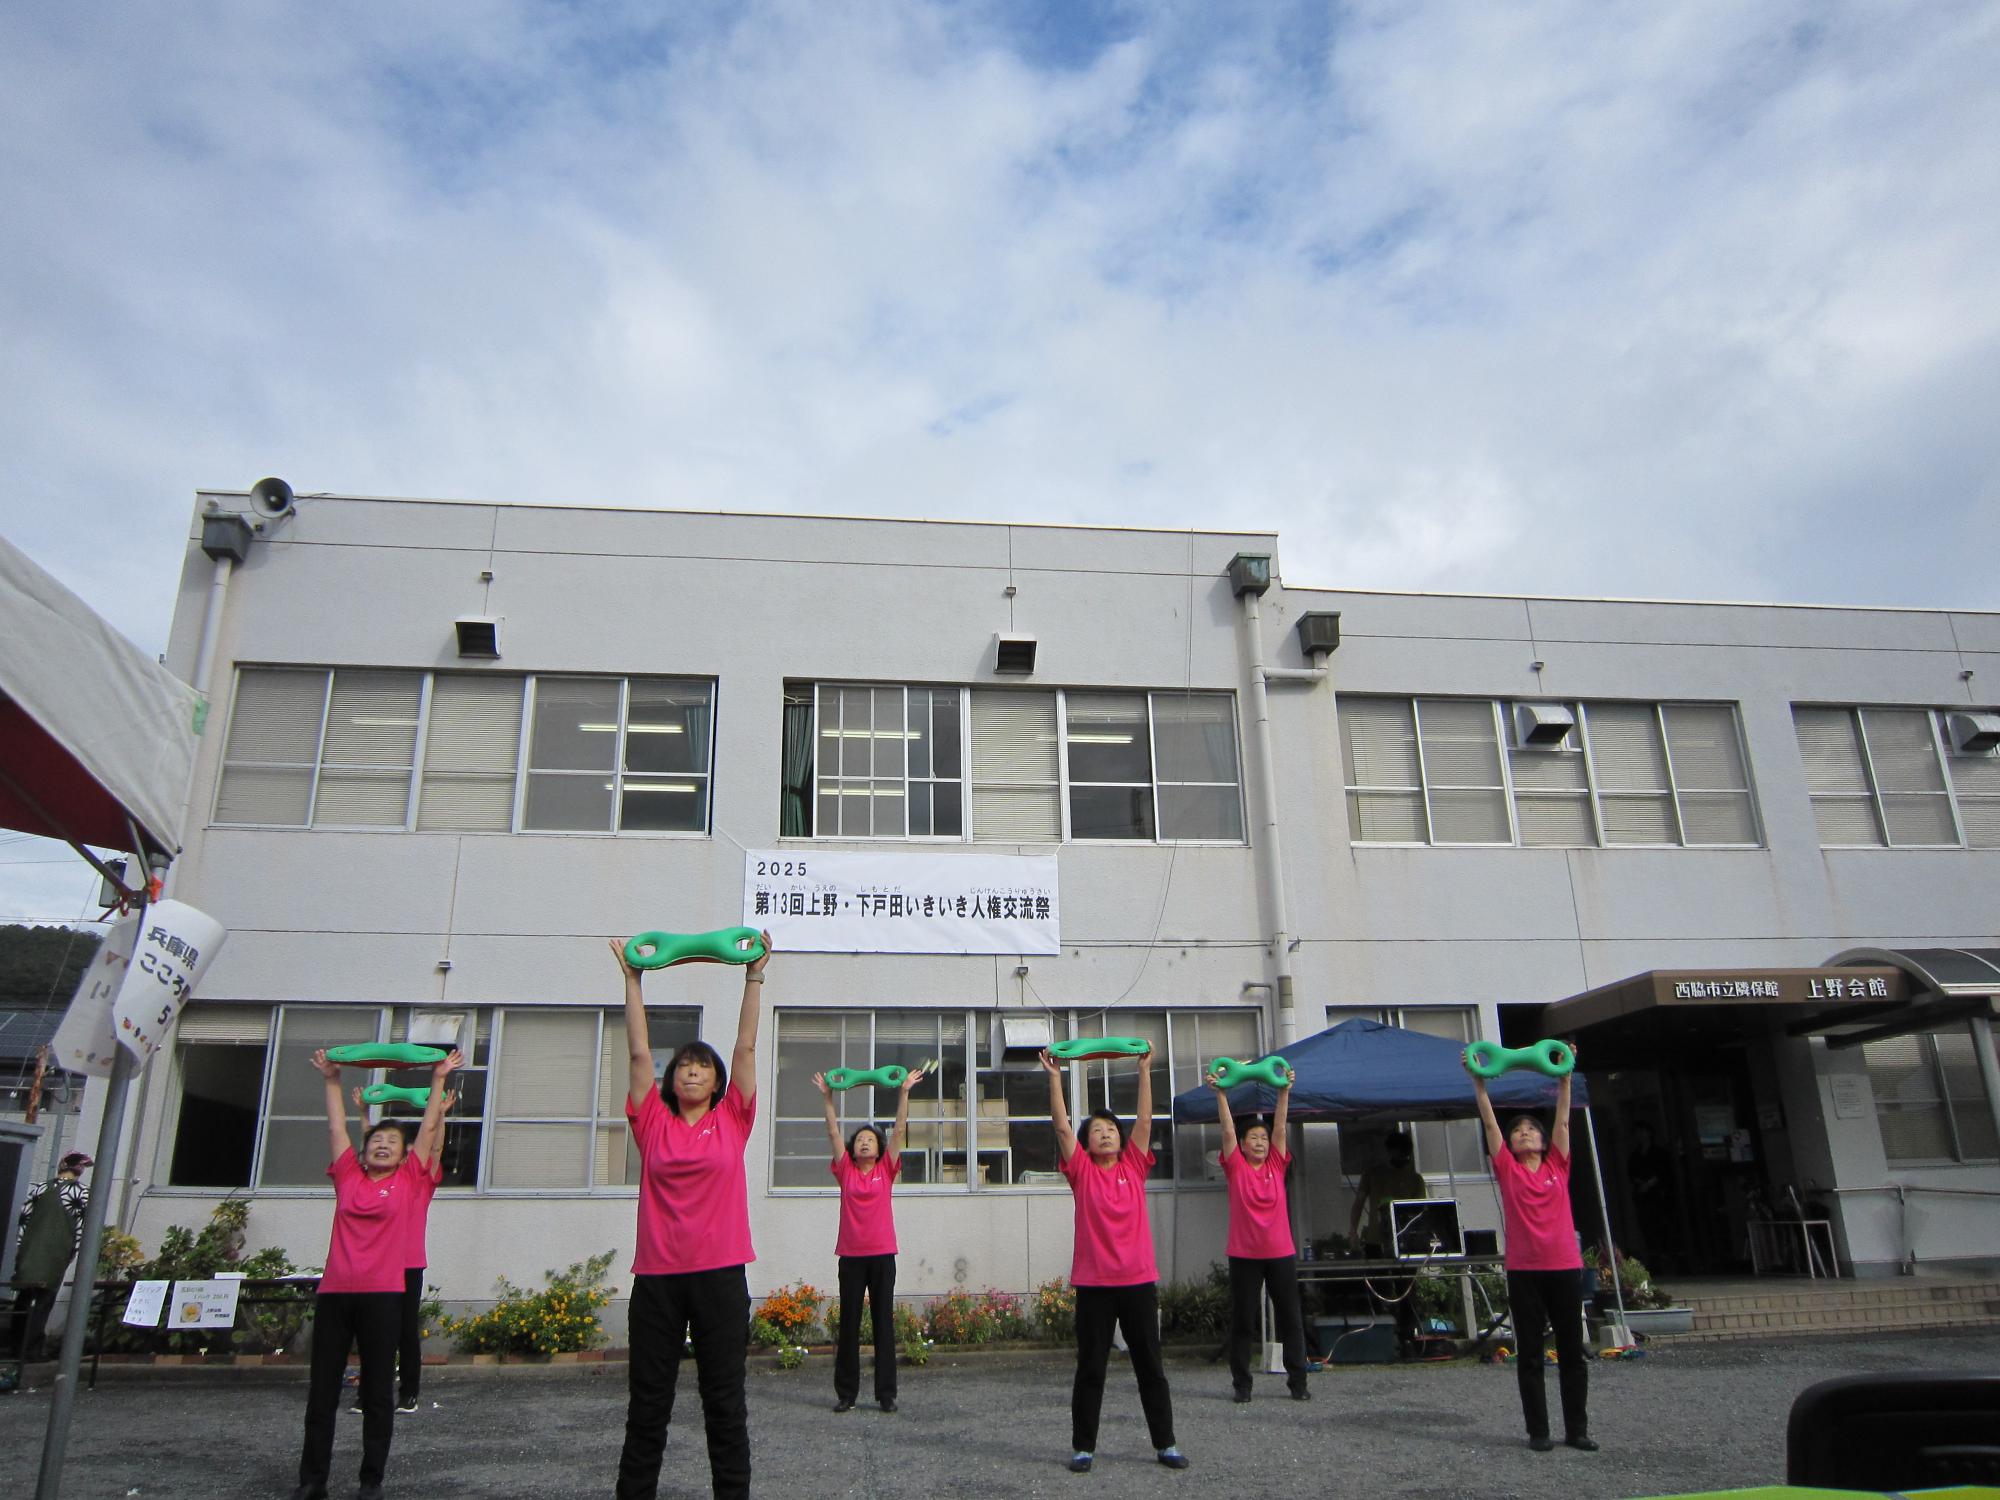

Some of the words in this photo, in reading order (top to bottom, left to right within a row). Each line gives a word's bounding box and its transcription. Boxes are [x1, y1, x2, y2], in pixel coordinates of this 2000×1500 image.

[757, 862, 807, 876] 2025
[860, 885, 901, 893] しもとだ
[755, 891, 1050, 920] 第13回上野・下戸田いきいき人権交流祭
[147, 926, 199, 970] 兵庫県
[1675, 982, 1779, 998] 西脇市立隣保館
[1807, 977, 1887, 998] 上野会館
